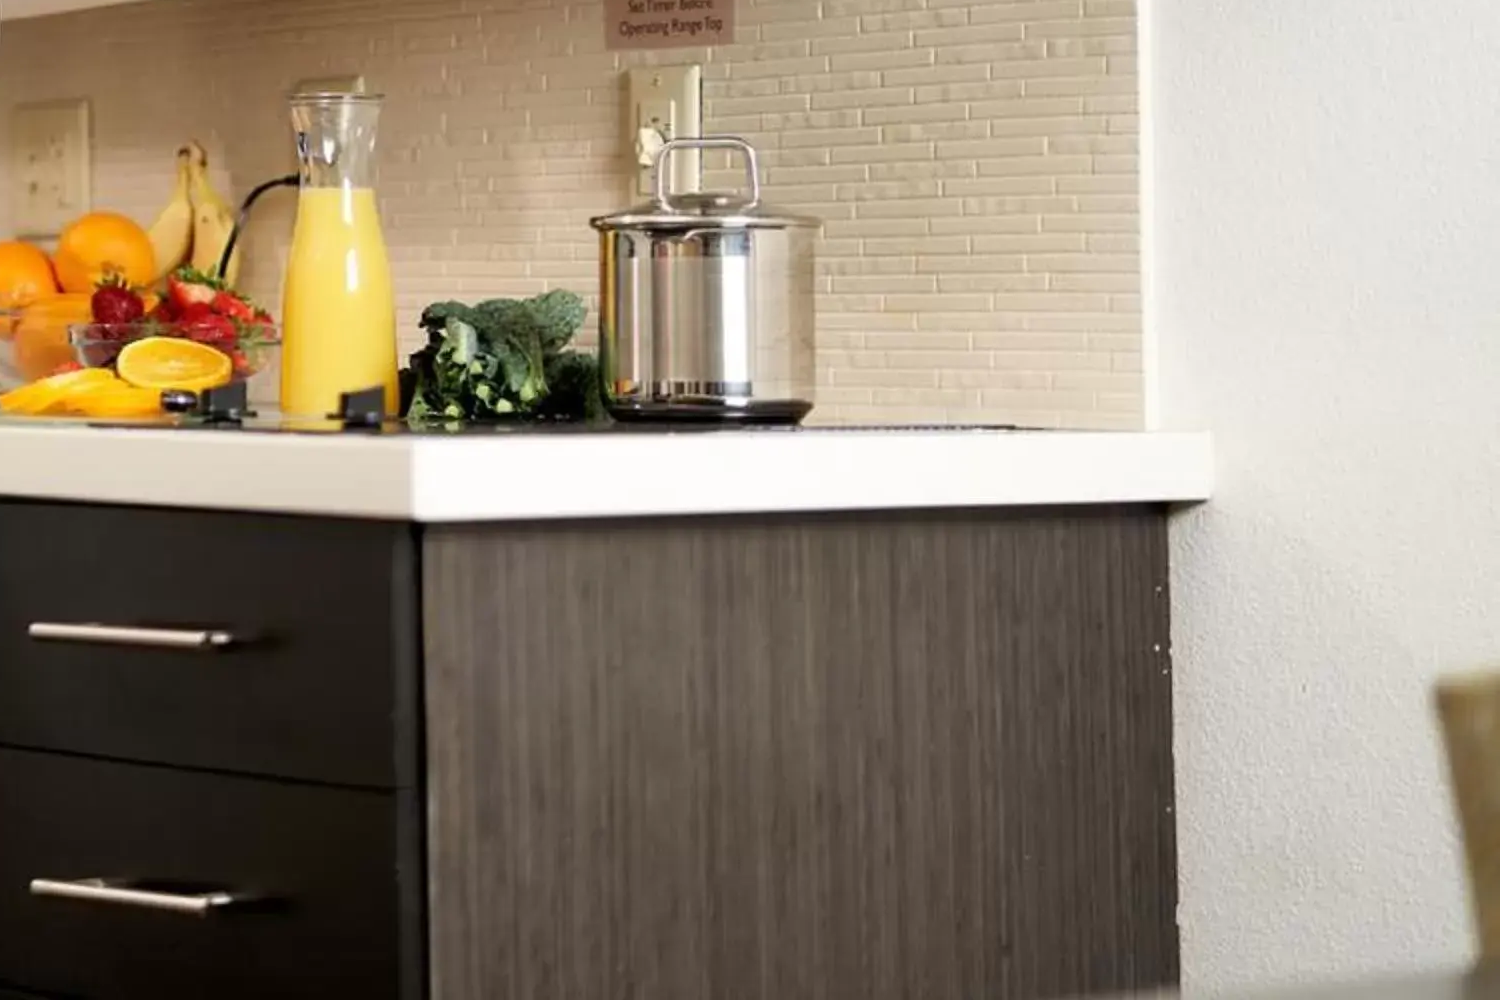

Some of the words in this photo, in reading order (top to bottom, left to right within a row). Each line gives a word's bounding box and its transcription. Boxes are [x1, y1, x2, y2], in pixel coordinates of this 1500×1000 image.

[619, 19, 670, 40] Operating
[671, 17, 703, 38] Range
[704, 14, 723, 35] Top
